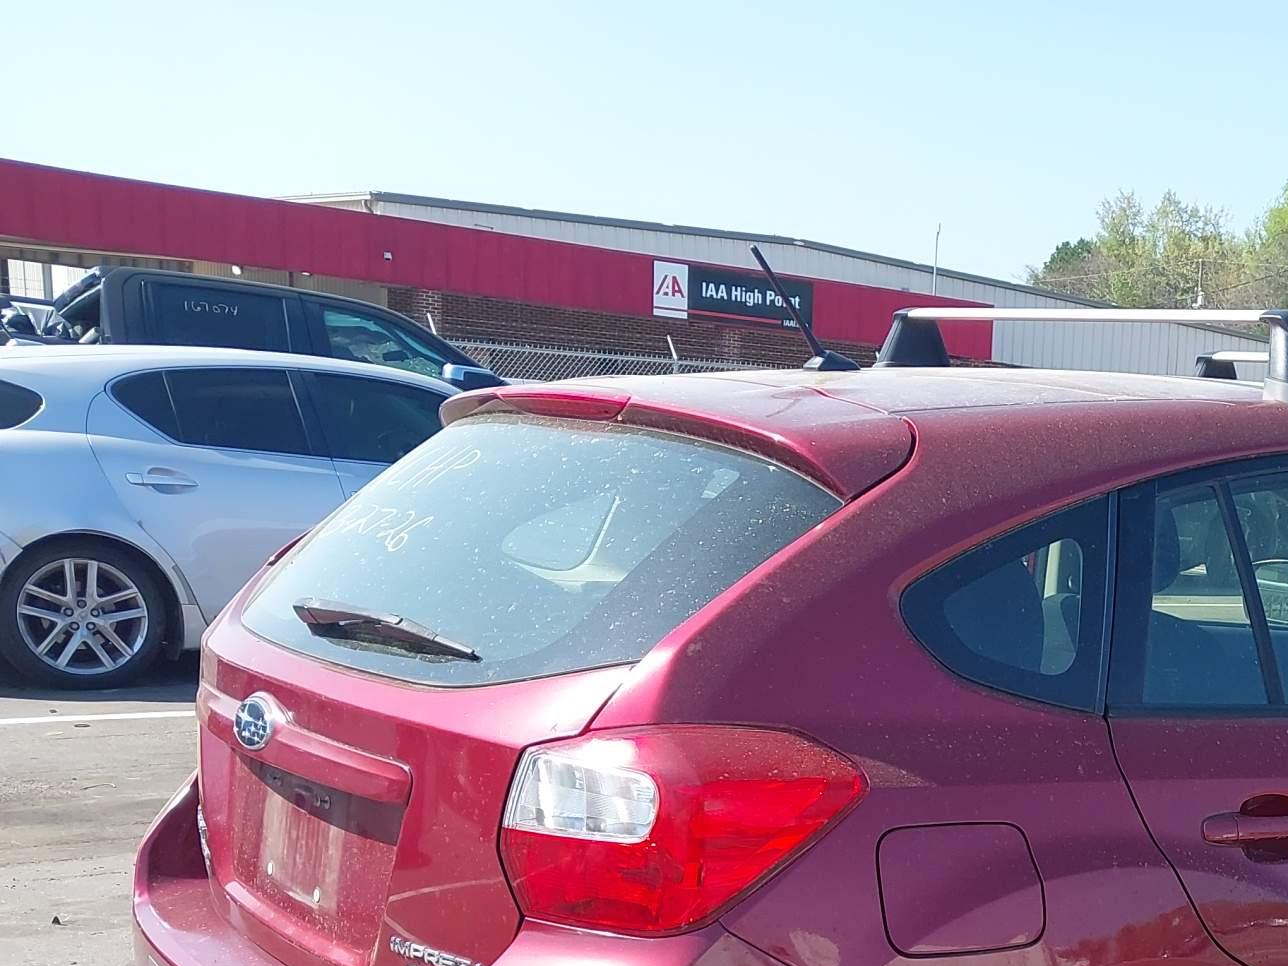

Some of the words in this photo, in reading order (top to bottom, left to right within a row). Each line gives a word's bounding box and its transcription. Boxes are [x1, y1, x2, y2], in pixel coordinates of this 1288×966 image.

[702, 281, 728, 300] IAA
[731, 286, 762, 307] High
[766, 290, 801, 310] Pot
